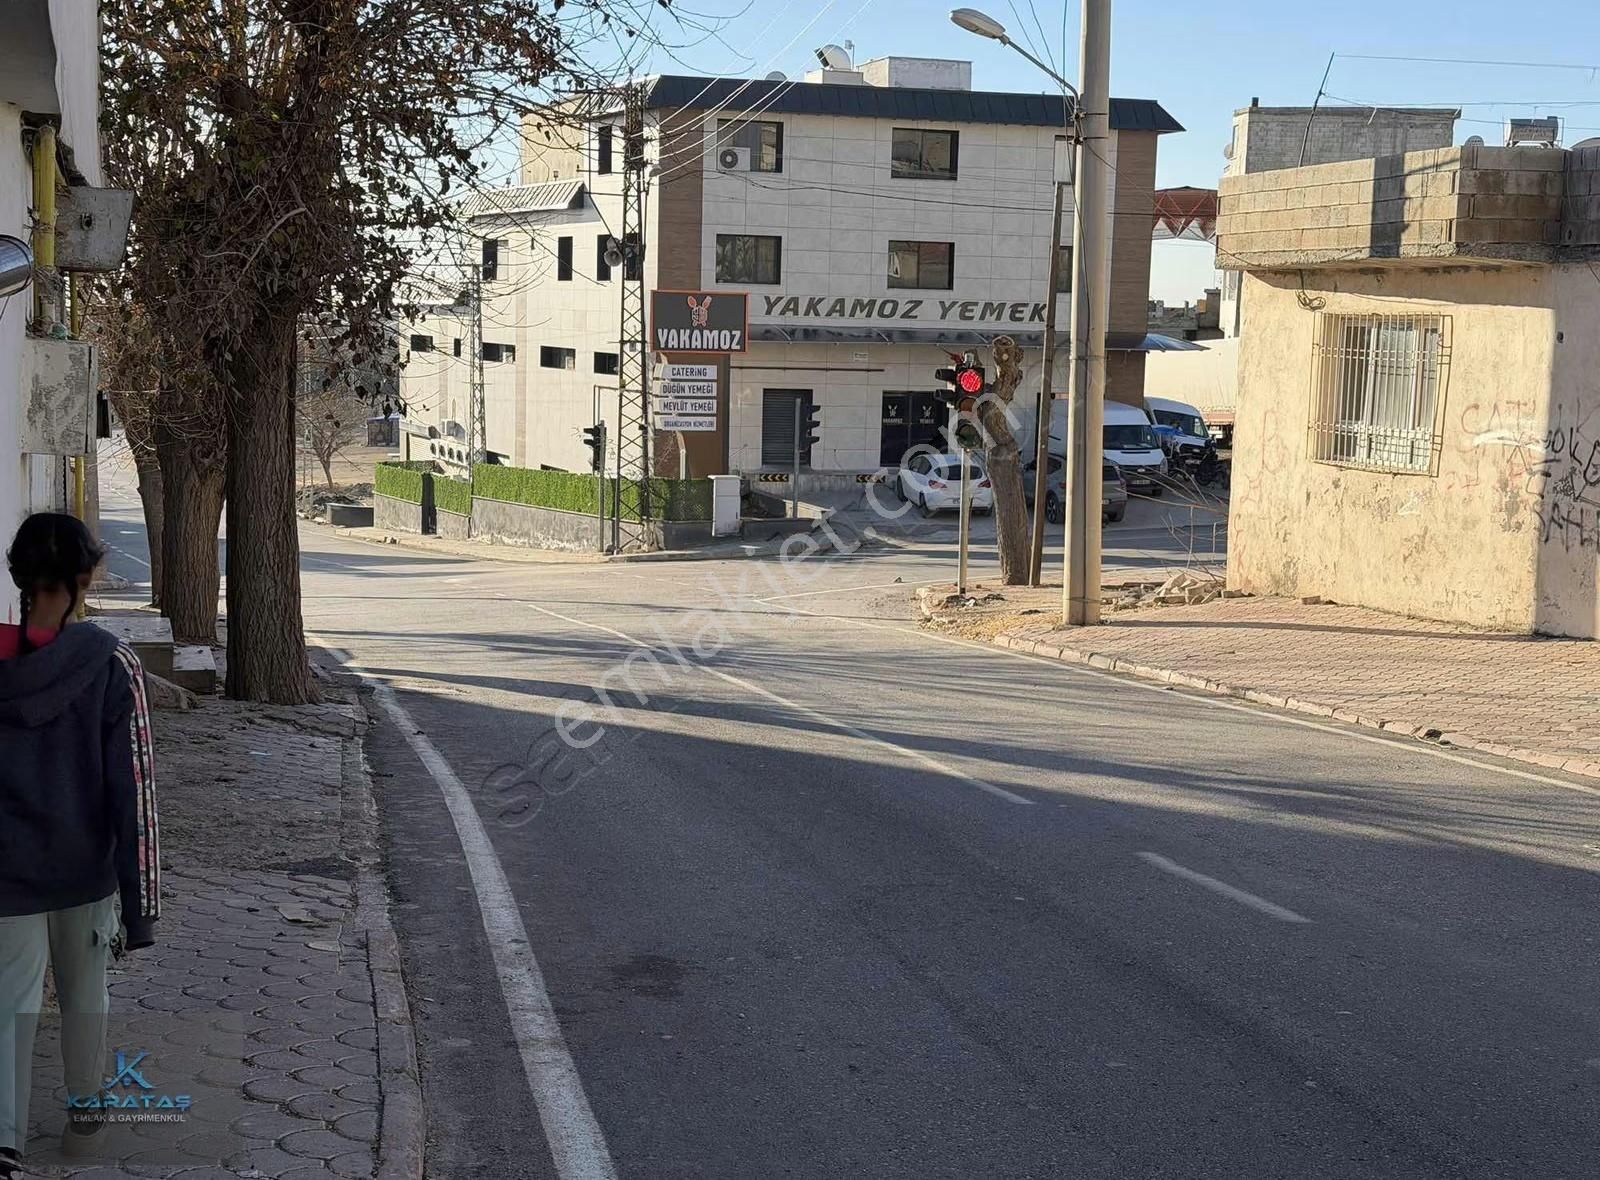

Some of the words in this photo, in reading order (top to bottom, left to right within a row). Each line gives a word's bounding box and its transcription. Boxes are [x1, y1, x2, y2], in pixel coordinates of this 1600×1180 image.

[764, 295, 922, 319] YAKAMOZ
[938, 301, 1047, 322] YEMEK
[657, 328, 741, 350] YAKAMOZ
[662, 383, 686, 395] DÜĞÜN
[663, 399, 688, 412] MEVLÜT
